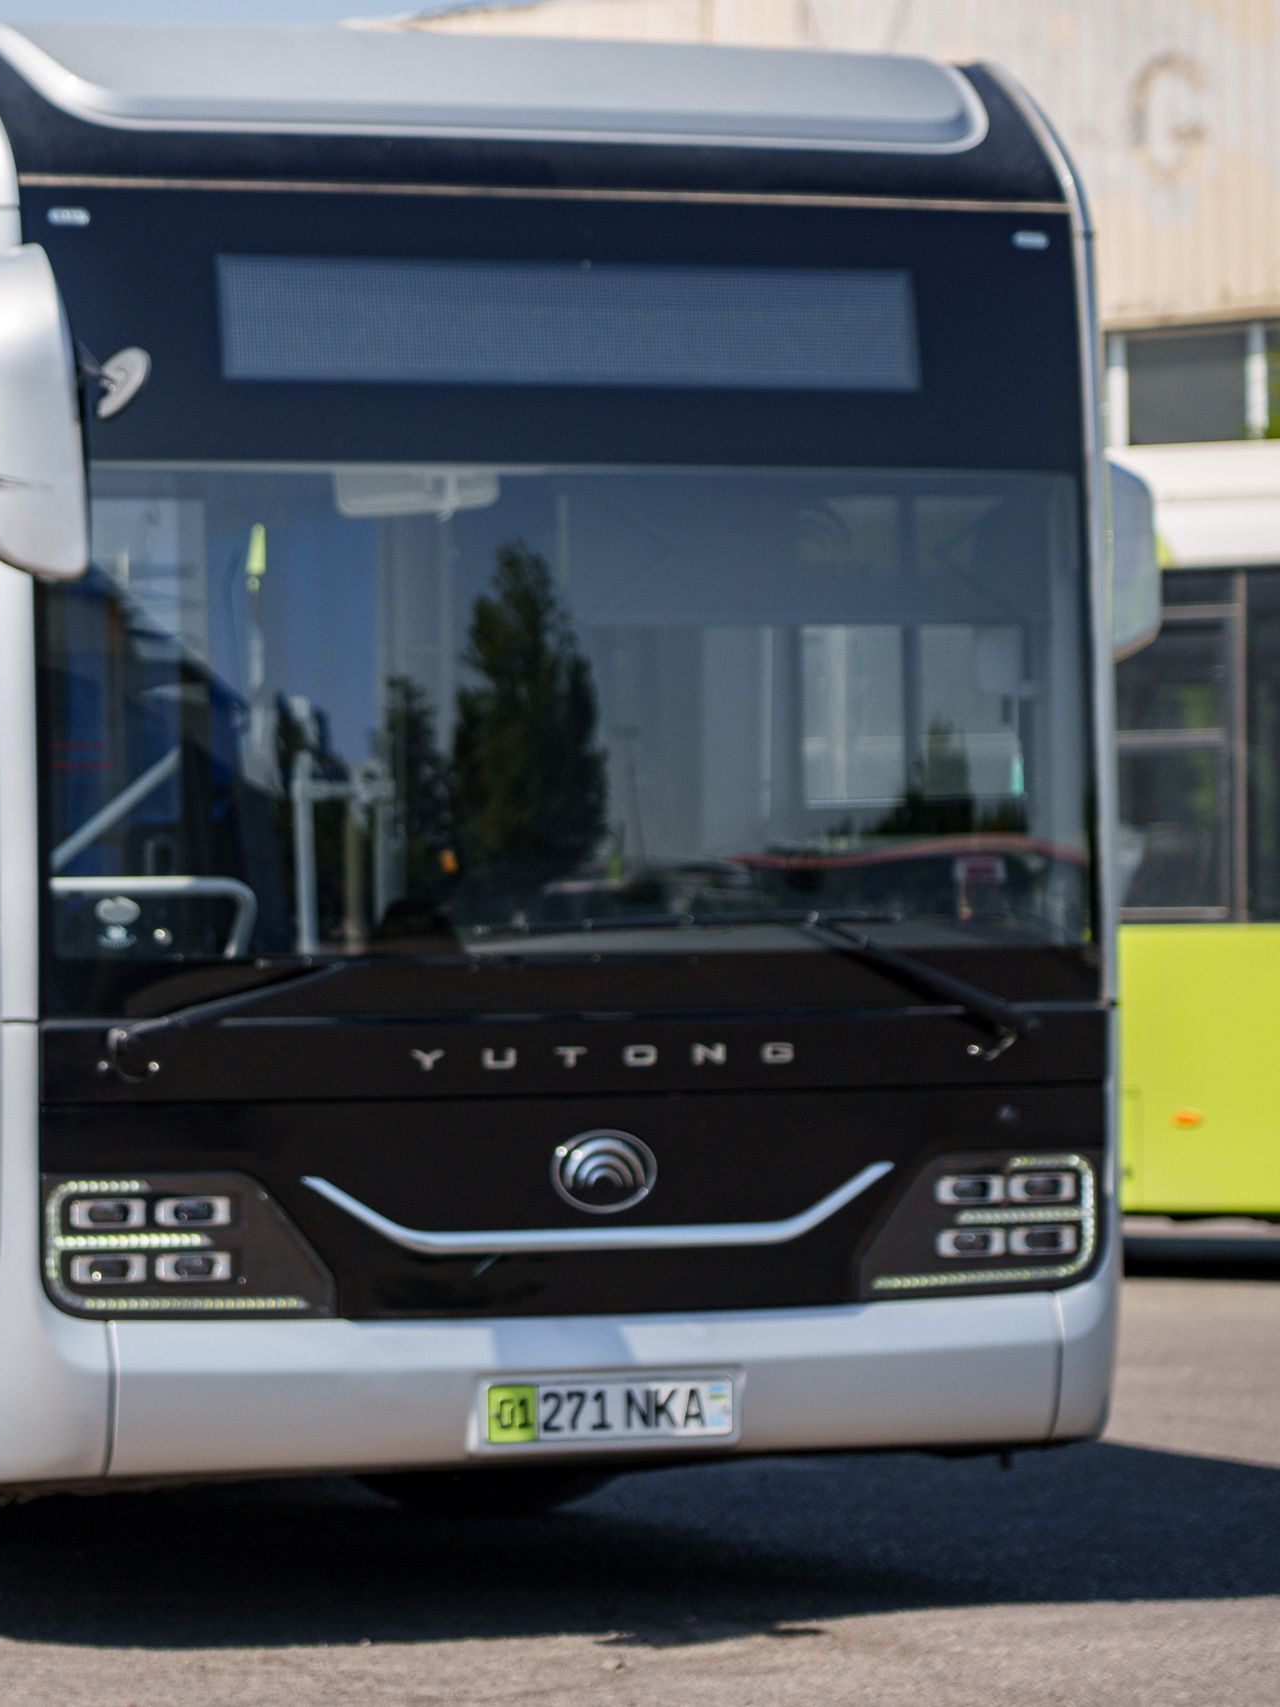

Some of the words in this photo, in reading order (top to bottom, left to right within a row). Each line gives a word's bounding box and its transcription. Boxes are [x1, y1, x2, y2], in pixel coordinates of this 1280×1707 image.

[411, 1041, 796, 1072] YUTONG
[497, 1397, 534, 1429] 01
[542, 1390, 611, 1433] 271
[624, 1387, 706, 1430] NKA
